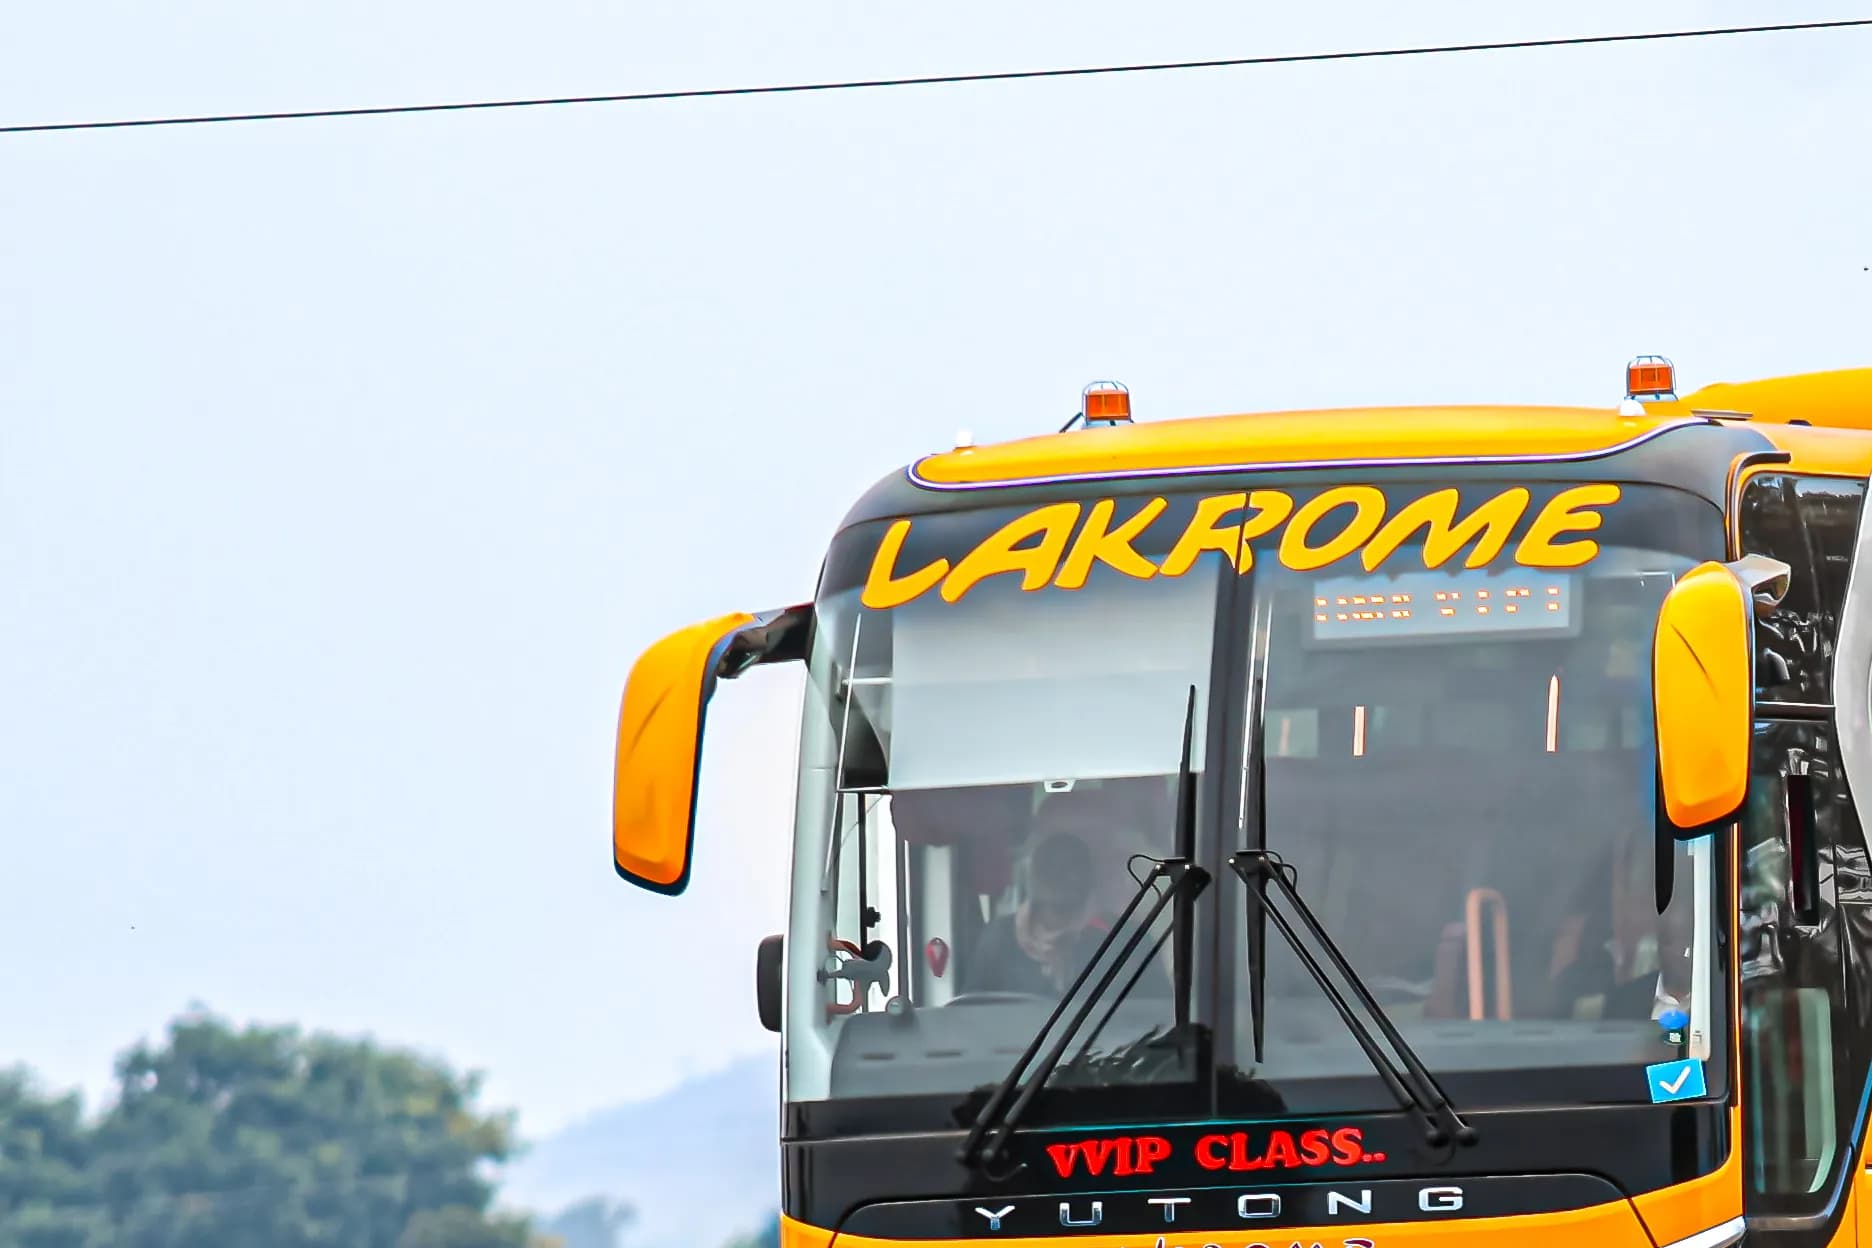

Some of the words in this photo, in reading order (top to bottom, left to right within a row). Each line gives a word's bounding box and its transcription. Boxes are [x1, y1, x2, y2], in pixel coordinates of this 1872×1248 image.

[861, 484, 1622, 610] LAKROME
[1046, 1136, 1172, 1179] VVIP
[974, 1186, 1465, 1231] YUTONG
